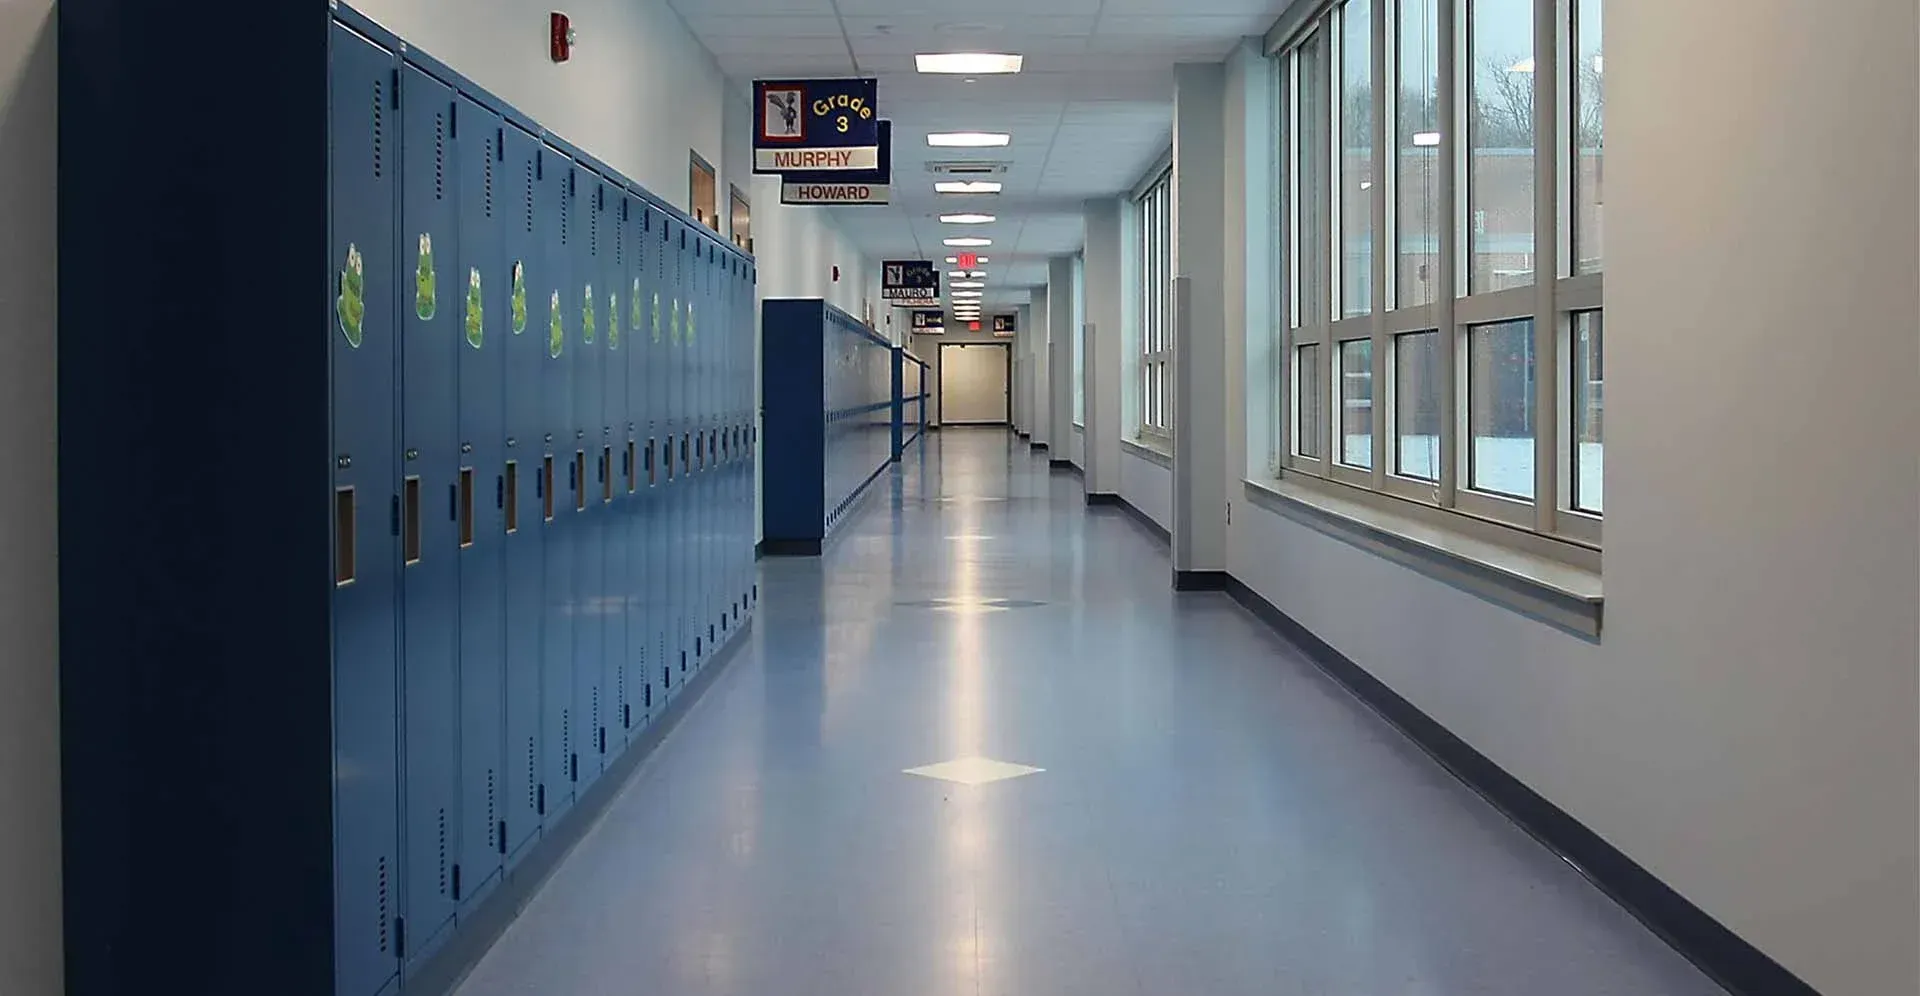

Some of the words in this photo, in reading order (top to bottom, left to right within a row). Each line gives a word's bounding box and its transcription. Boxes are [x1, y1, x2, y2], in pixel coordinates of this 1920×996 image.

[813, 95, 872, 120] Grade
[836, 116, 849, 132] 3
[774, 151, 852, 168] MURPHY
[798, 185, 870, 200] HOWARD
[889, 288, 928, 298] MAURO
